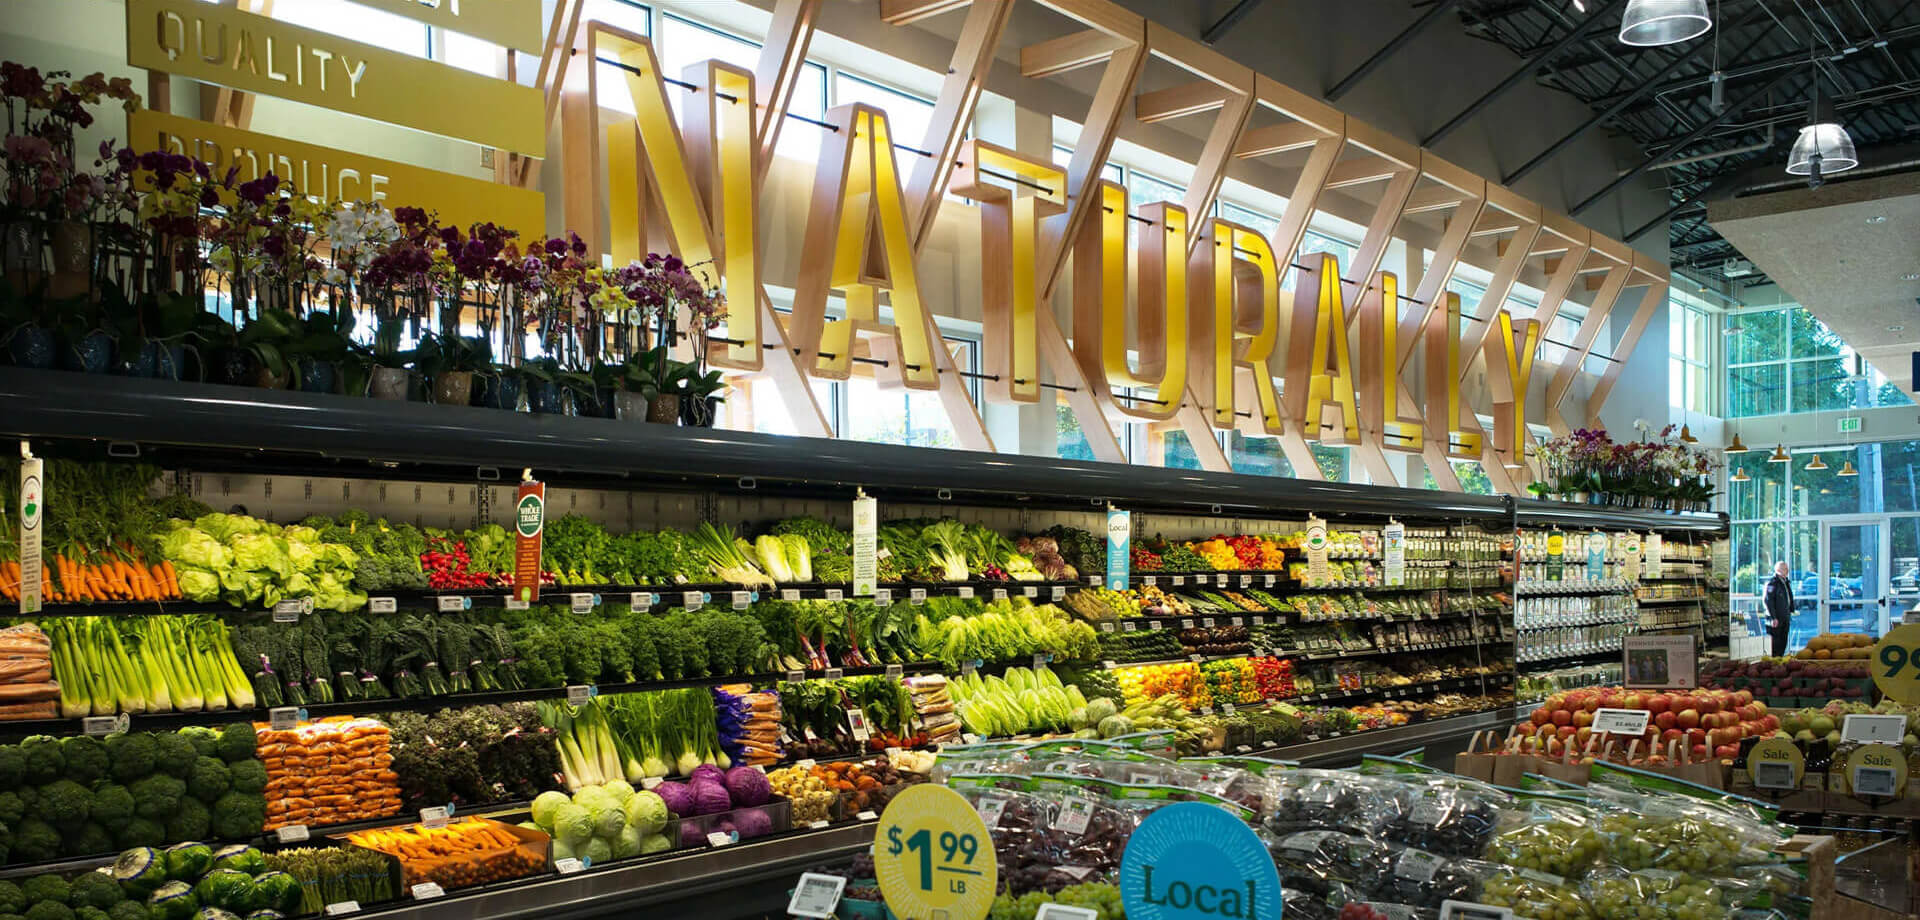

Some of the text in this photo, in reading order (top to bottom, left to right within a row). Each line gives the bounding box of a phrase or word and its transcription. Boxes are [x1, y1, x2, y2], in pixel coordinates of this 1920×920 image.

[157, 10, 367, 98] QUALITY
[563, 20, 1539, 468] NATURALLY
[1841, 419, 1858, 430] EXIT
[520, 505, 541, 514] WHOLE
[520, 514, 540, 522] TRADE
[1109, 523, 1128, 532] Local
[1762, 749, 1790, 761] Sale
[1863, 753, 1893, 767] Sale
[950, 878, 966, 894] LB
[1142, 865, 1257, 920] Local
